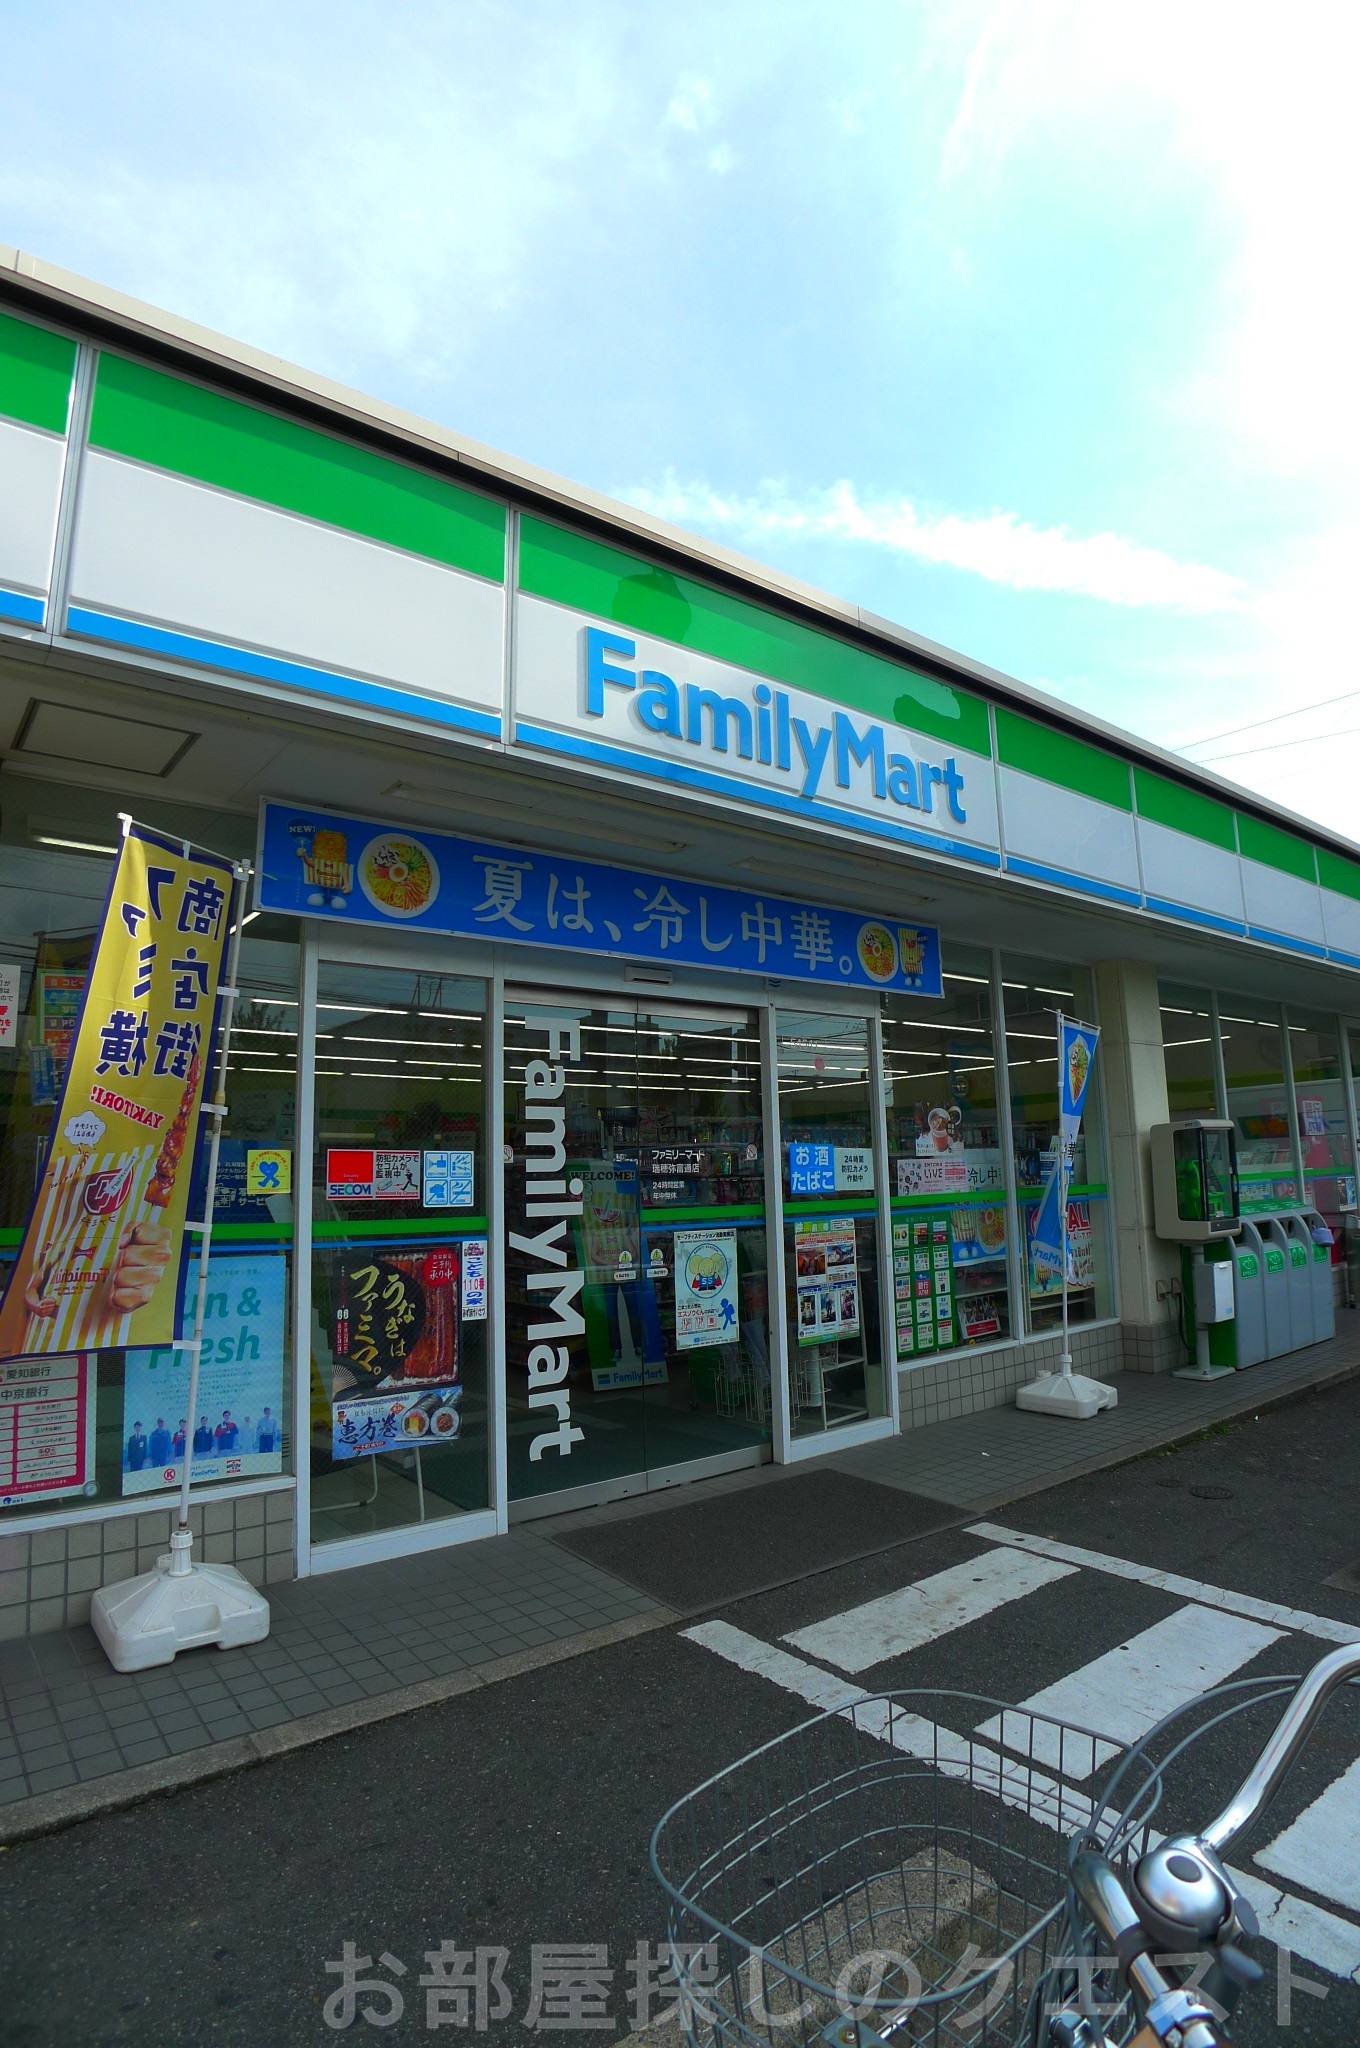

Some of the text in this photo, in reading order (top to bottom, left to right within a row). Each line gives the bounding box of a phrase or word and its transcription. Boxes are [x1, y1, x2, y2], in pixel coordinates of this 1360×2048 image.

[586, 625, 967, 824] FamilyMart
[289, 825, 316, 833] NEW!
[472, 854, 853, 976] 夏は、冷し中華。
[375, 1153, 419, 1163] 防犯カメラで
[651, 1150, 705, 1160] ファミリーマート
[795, 1145, 829, 1166] お酒
[844, 1155, 864, 1164] 24時間
[375, 1162, 408, 1171] セコムが
[651, 1164, 700, 1174] 瑞穂弥富通店
[841, 1164, 869, 1173] 防犯カメラ
[375, 1170, 401, 1179] 監視中
[569, 1171, 636, 1182] WELCOME!
[846, 1174, 864, 1183] 作動中
[924, 1169, 942, 1179] LIVE
[652, 1181, 685, 1190] 24時間営業
[791, 1170, 835, 1191] たばこ
[330, 1184, 371, 1195] SECOM
[238, 1197, 266, 1206] サービ
[652, 1192, 677, 1200] 年中無休
[1067, 1202, 1091, 1232] AL
[508, 1016, 586, 1462] FamilyMart
[432, 1260, 452, 1269] ご予約
[429, 1268, 453, 1280] 承り中
[701, 1277, 713, 1285] SS
[184, 1286, 262, 1322] un &
[350, 1265, 382, 1376] ファミマ。
[382, 1273, 416, 1357] うなぎは
[6, 1366, 52, 1380] 愛知銀行
[613, 1368, 663, 1383] FamilyMart
[1, 1386, 49, 1401] 中京銀行
[338, 1412, 398, 1445] 恵方巻
